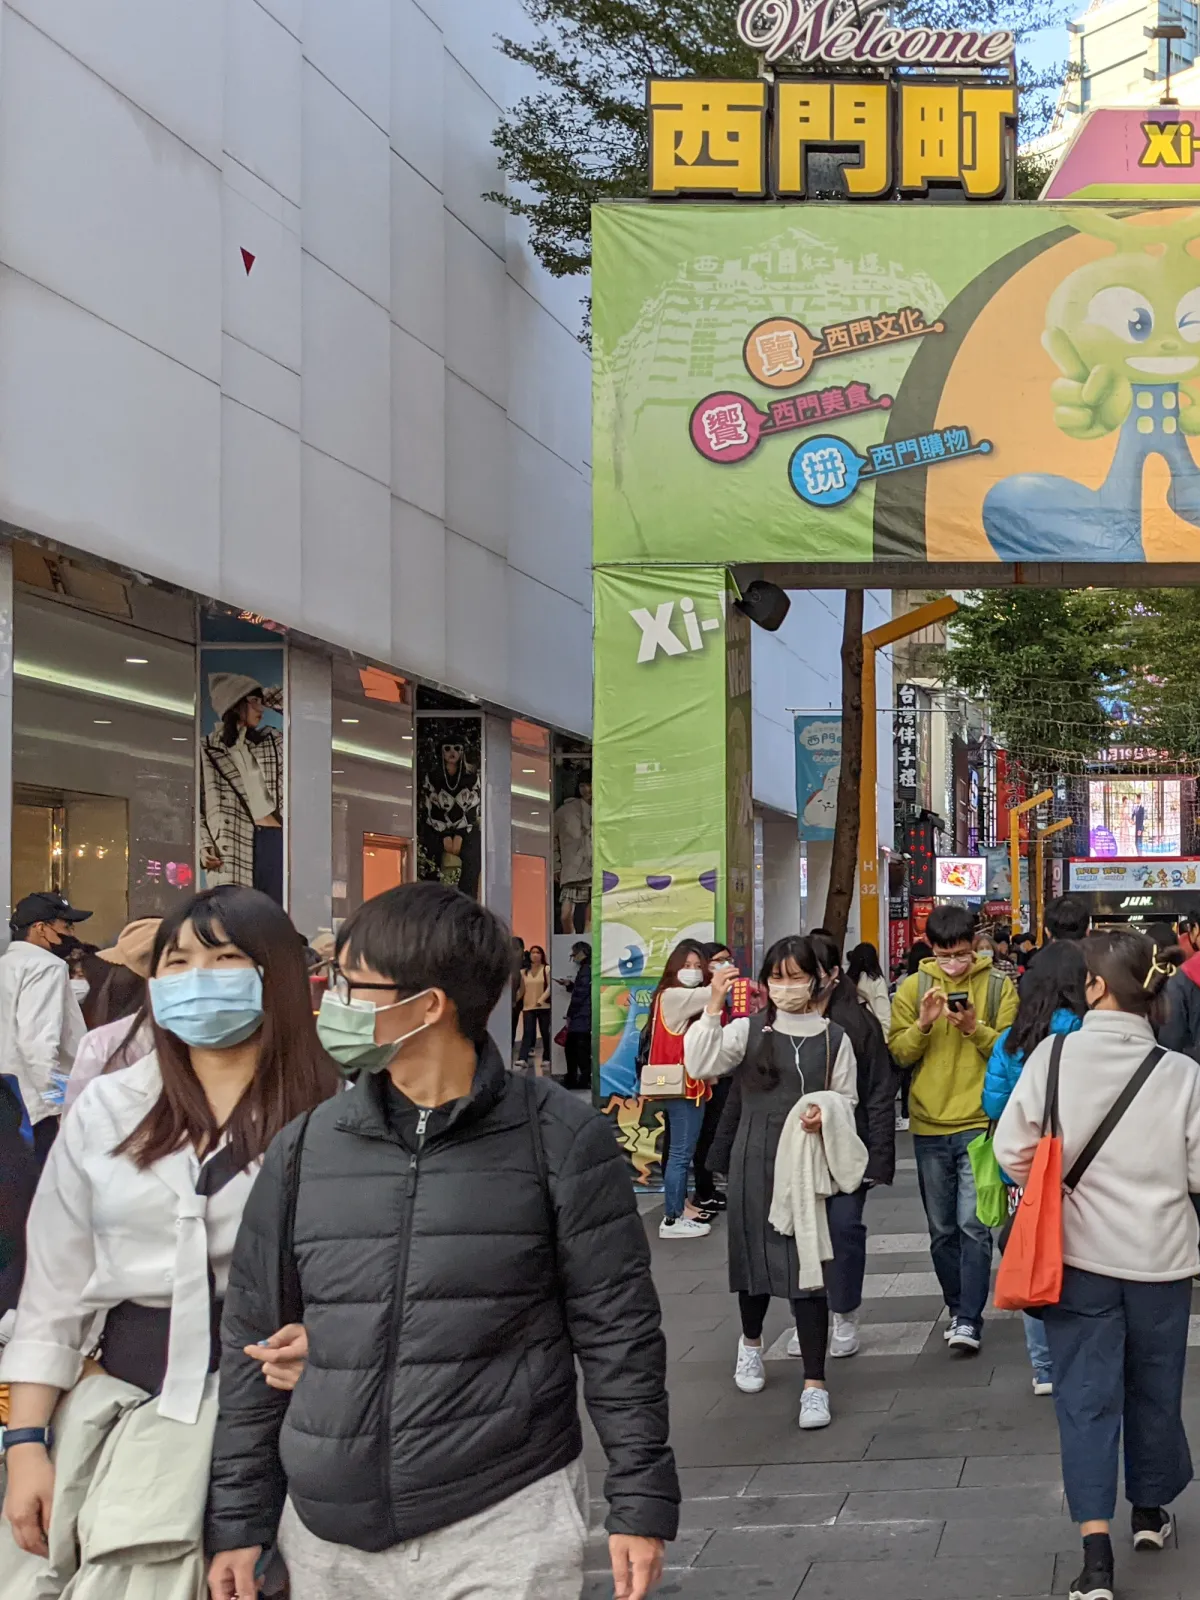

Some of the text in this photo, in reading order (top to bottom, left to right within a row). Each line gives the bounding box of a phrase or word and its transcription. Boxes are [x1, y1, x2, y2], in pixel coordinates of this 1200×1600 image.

[737, 0, 1016, 65] Welcome
[649, 79, 1018, 196] 西門町
[824, 309, 925, 350] 西門文化
[771, 384, 870, 426] 西門美食
[871, 428, 970, 470] 西門購物
[801, 447, 847, 495] 拼
[863, 860, 874, 872] H
